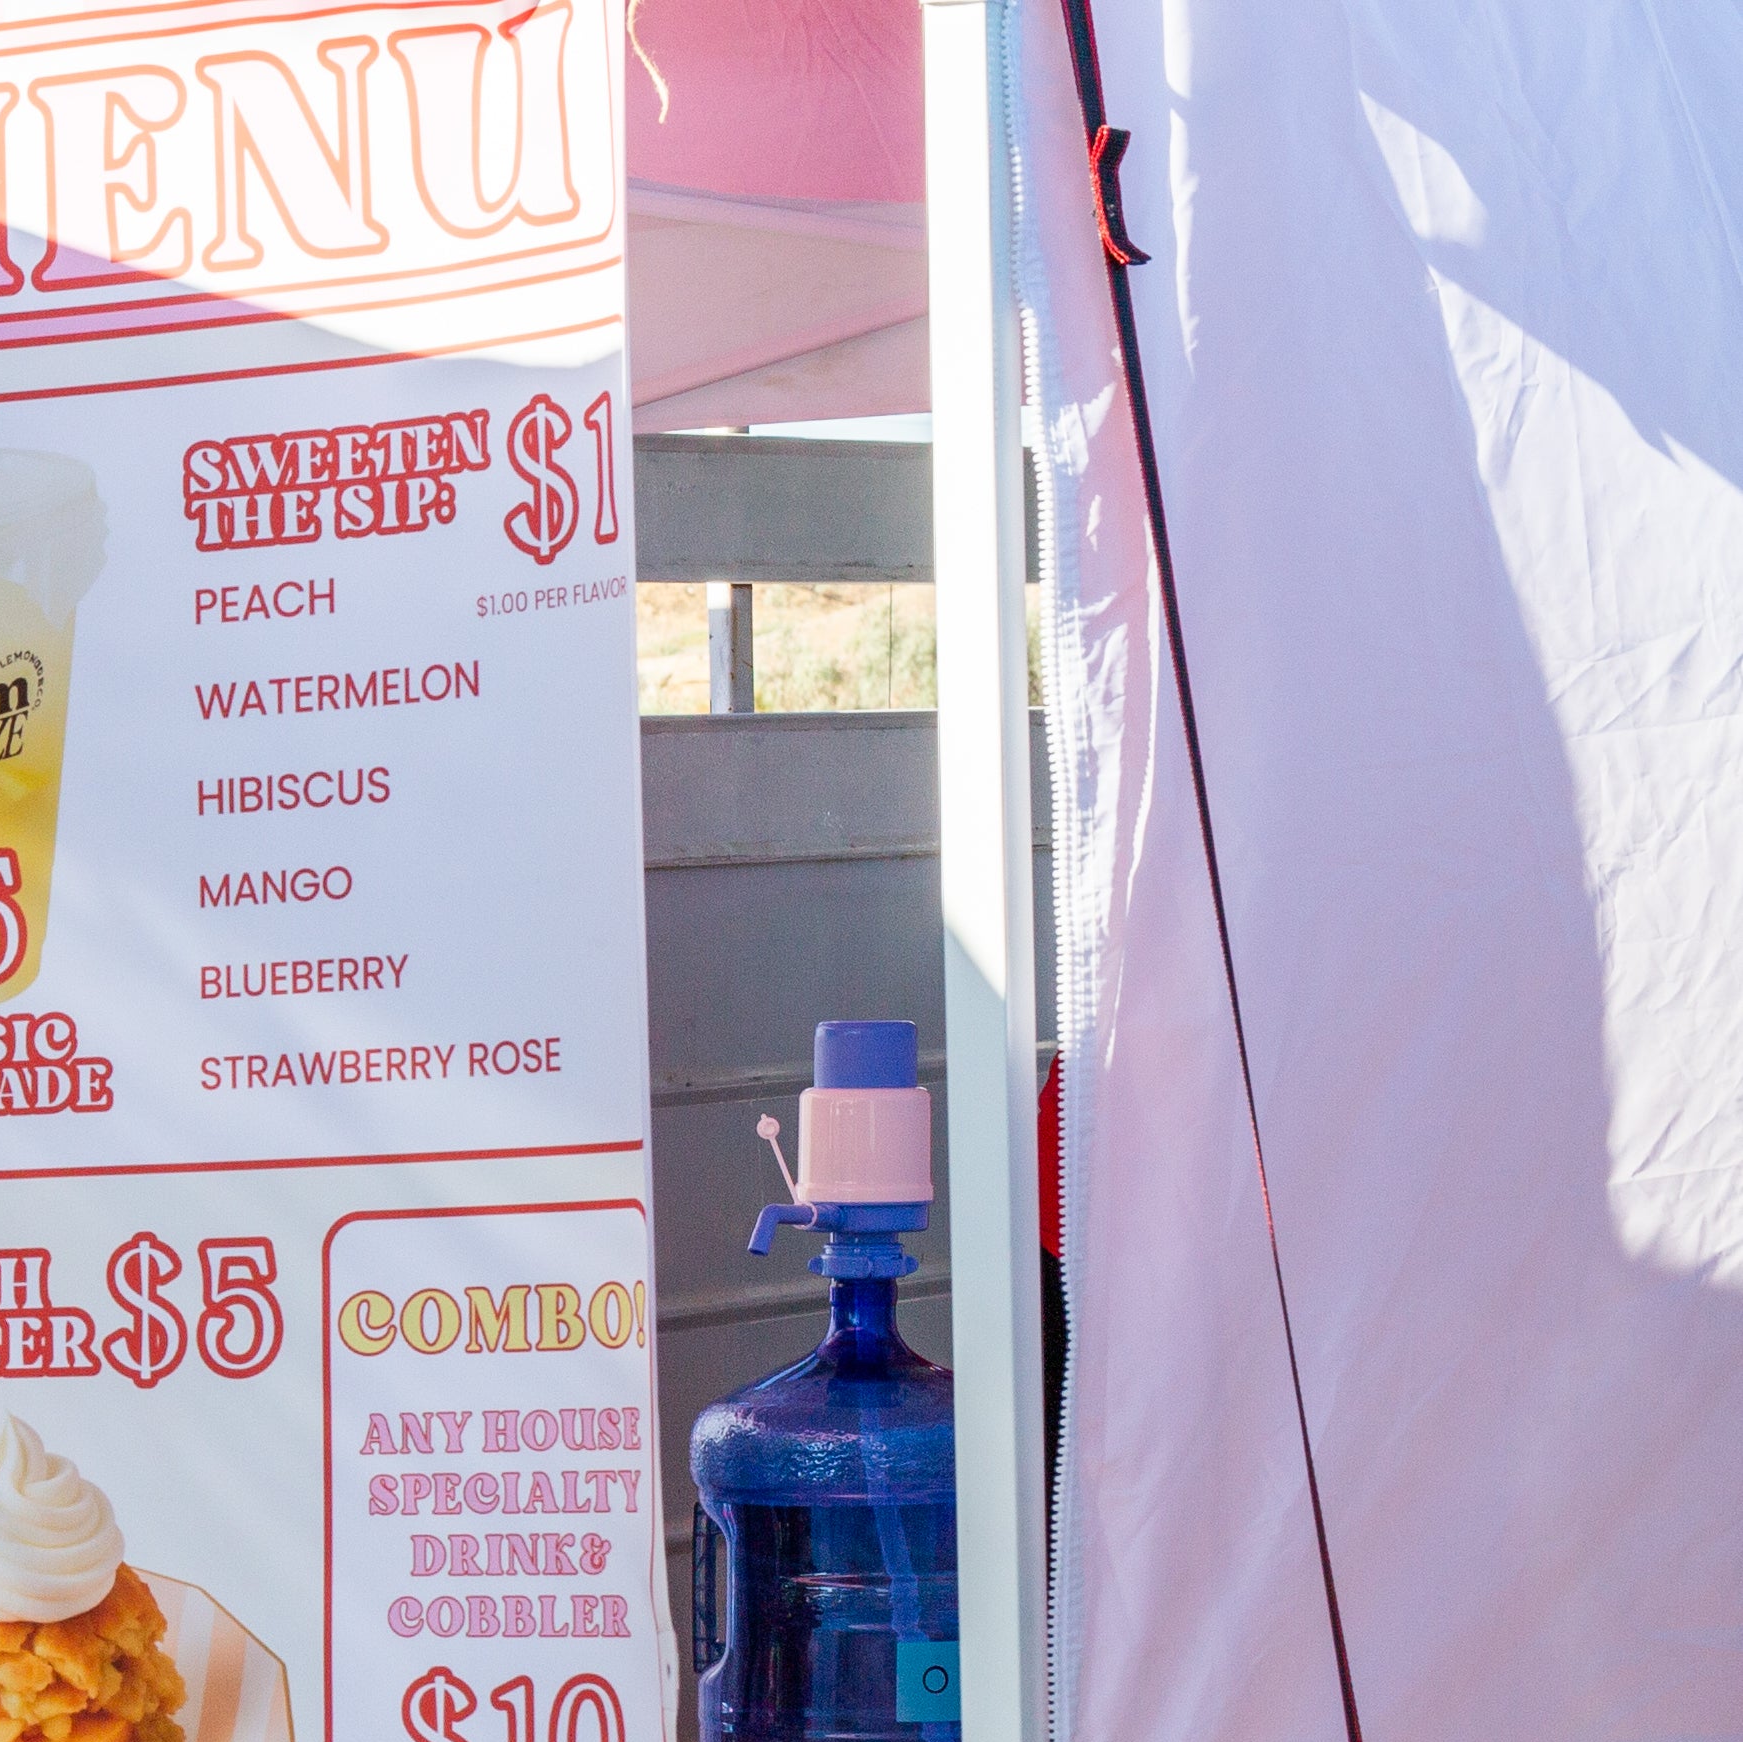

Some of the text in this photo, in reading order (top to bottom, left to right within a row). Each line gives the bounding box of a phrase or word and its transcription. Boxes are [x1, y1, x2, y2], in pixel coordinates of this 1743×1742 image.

[184, 408, 491, 498] SWEETEN
[503, 390, 619, 566] $1
[184, 476, 457, 552] THE SIP:
[194, 578, 336, 625] PEACH
[476, 575, 628, 618] $1.00 PER FLAVOR
[195, 660, 482, 721] WATERMELON
[197, 767, 391, 816] HIBISCUS
[198, 866, 354, 909] MANGO
[199, 953, 410, 999] BLUEBERRY
[200, 1036, 562, 1092] STRAWBERRY ROSE
[101, 1231, 284, 1389] $5
[338, 1281, 647, 1356] COMBO!
[359, 1406, 643, 1456] ANY HOUSE
[368, 1469, 643, 1516] SPECIALTY
[386, 1593, 633, 1639] COBBLER
